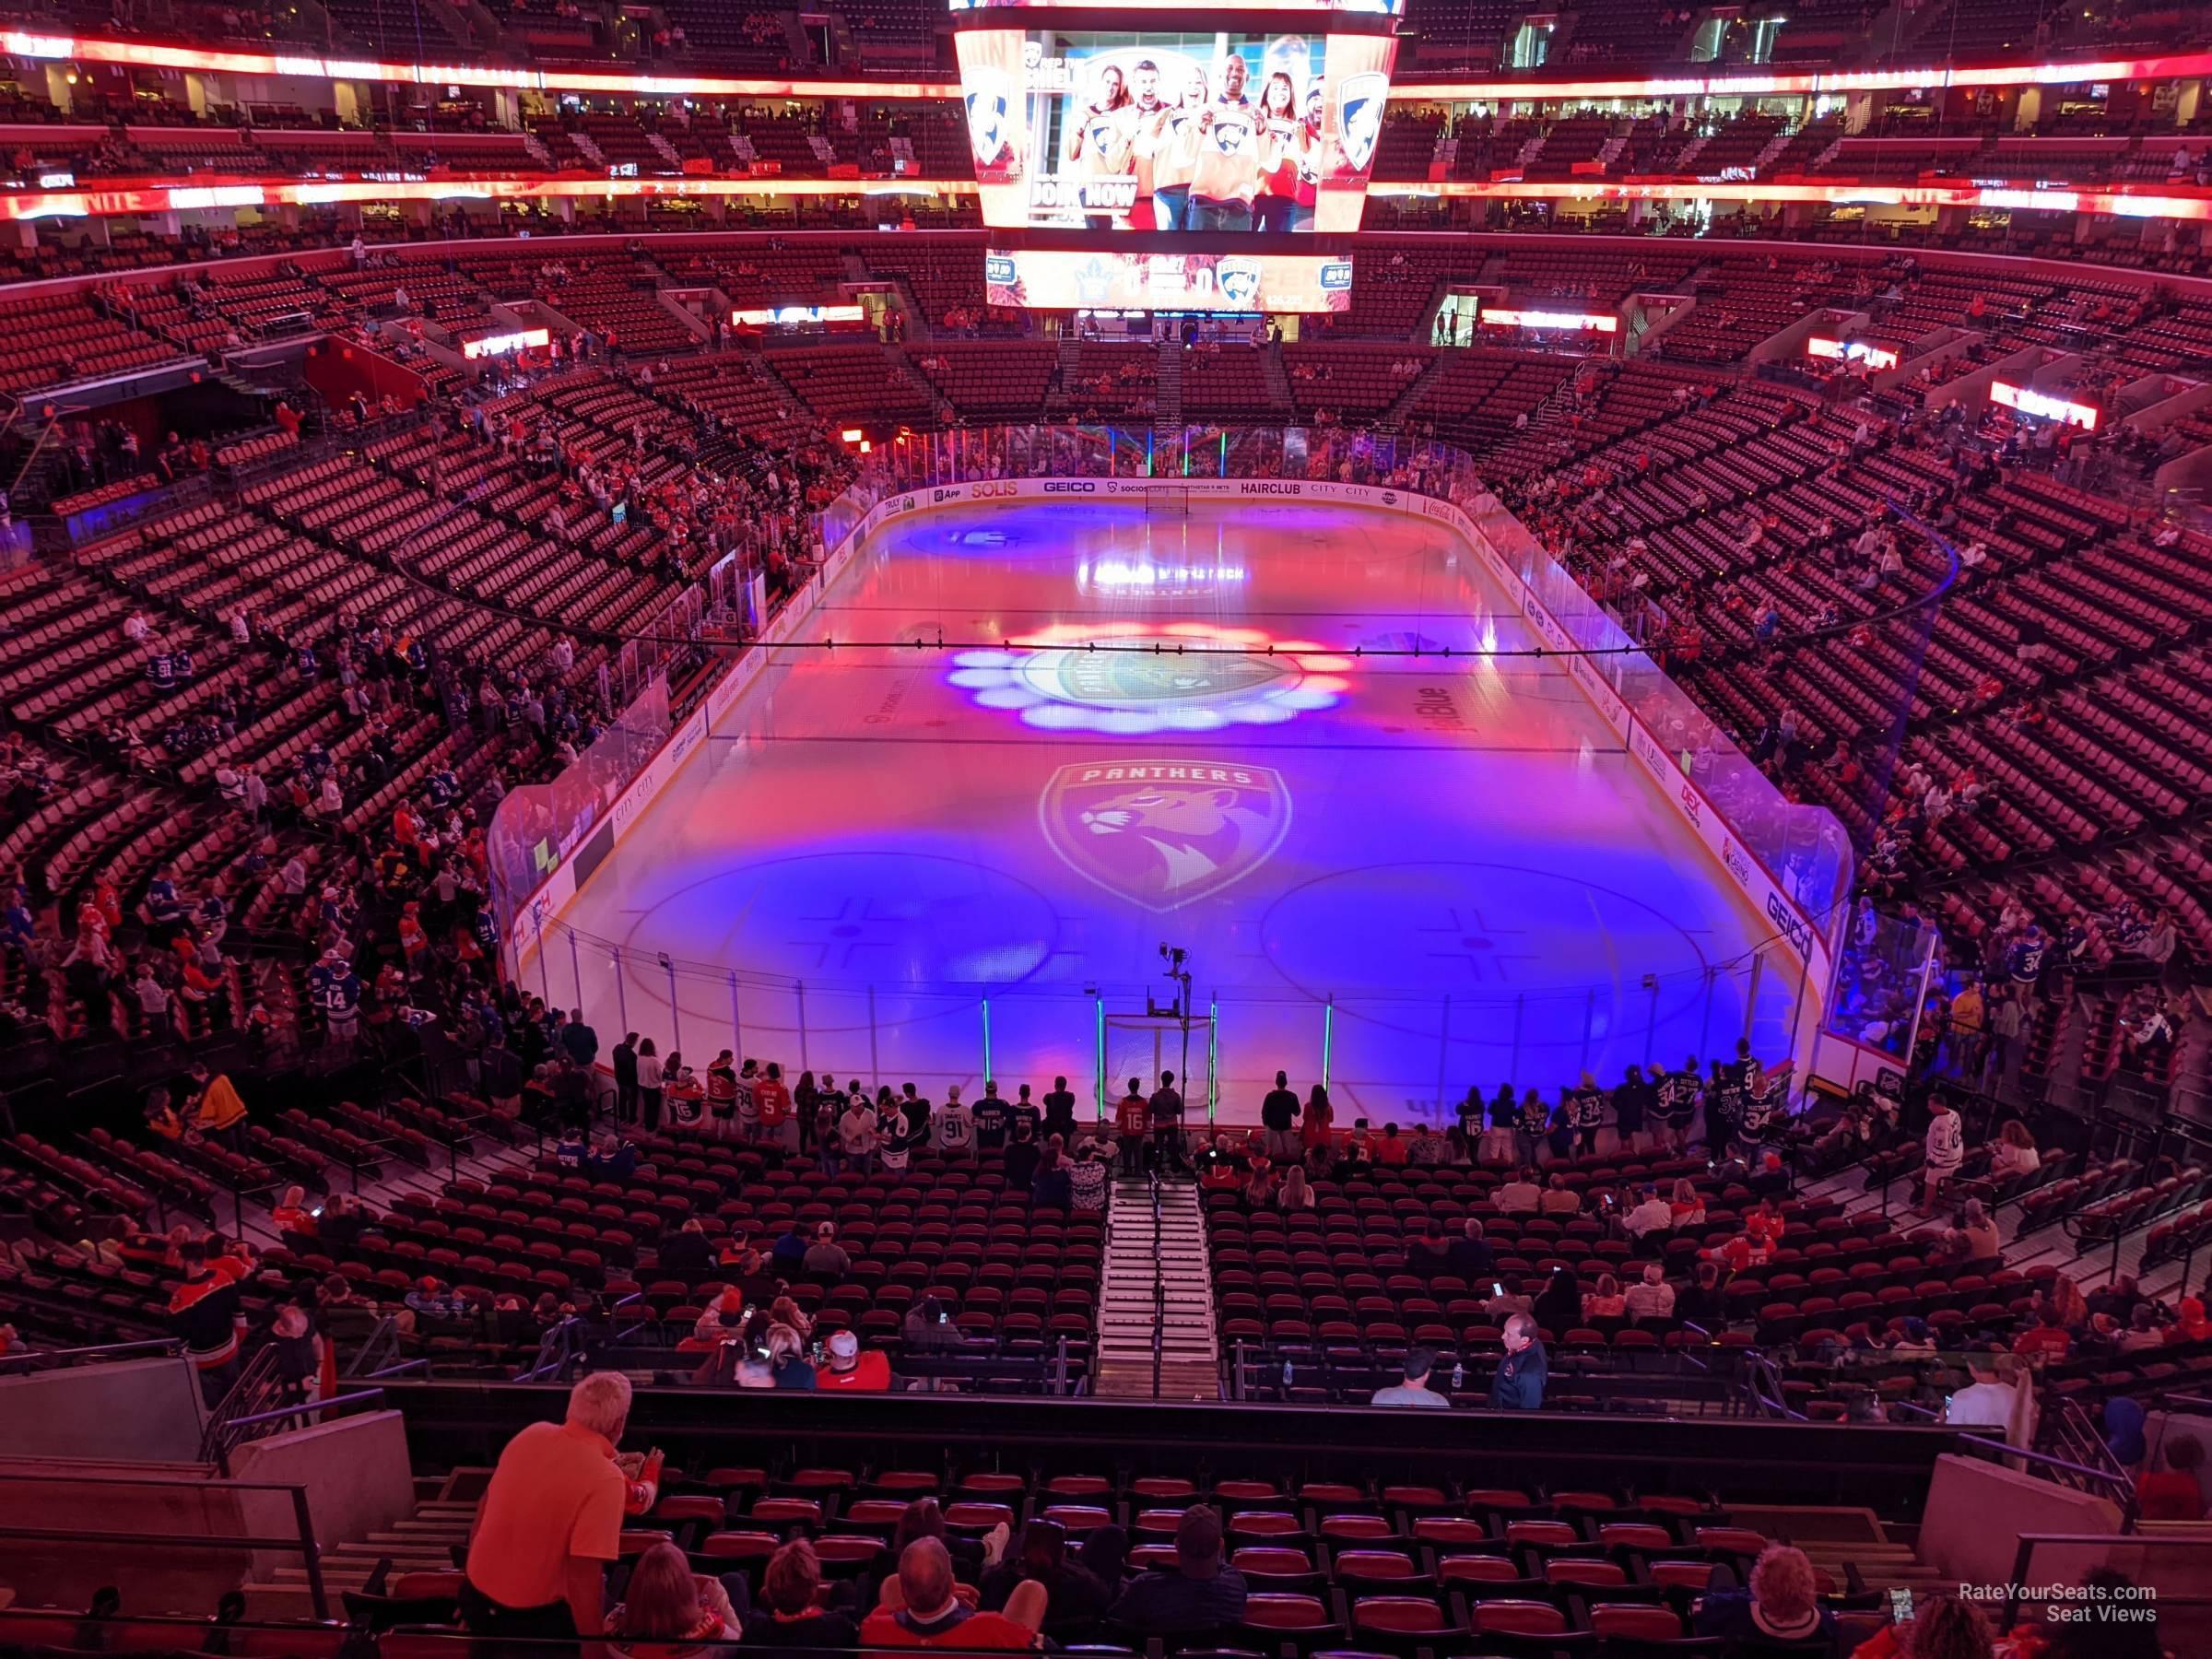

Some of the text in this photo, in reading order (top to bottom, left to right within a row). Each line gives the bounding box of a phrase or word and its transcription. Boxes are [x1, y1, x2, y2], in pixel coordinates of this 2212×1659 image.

[1086, 182, 1138, 206] NOW
[1196, 267, 1213, 298] 0
[971, 481, 1018, 499] SOLIS
[1043, 482, 1096, 492] GEICO
[1241, 483, 1301, 495] HAIRCLUB
[1311, 484, 1336, 493] CITY
[1346, 487, 1371, 497] CITY
[725, 613, 735, 623] G
[1081, 766, 1253, 784] PANTHERS
[1681, 783, 1701, 817] DEX
[1730, 853, 1749, 882] CASINO
[1767, 891, 1812, 962] GEICO
[325, 991, 347, 1009] 14
[1658, 1084, 1675, 1107] 34
[1675, 1086, 1698, 1105] 27
[764, 1099, 775, 1114] 5
[945, 1121, 962, 1139] 91
[983, 1117, 1000, 1131] 16
[1127, 1113, 1143, 1130] 16
[1465, 1120, 1482, 1136] 16
[1744, 1112, 1771, 1130] 34
